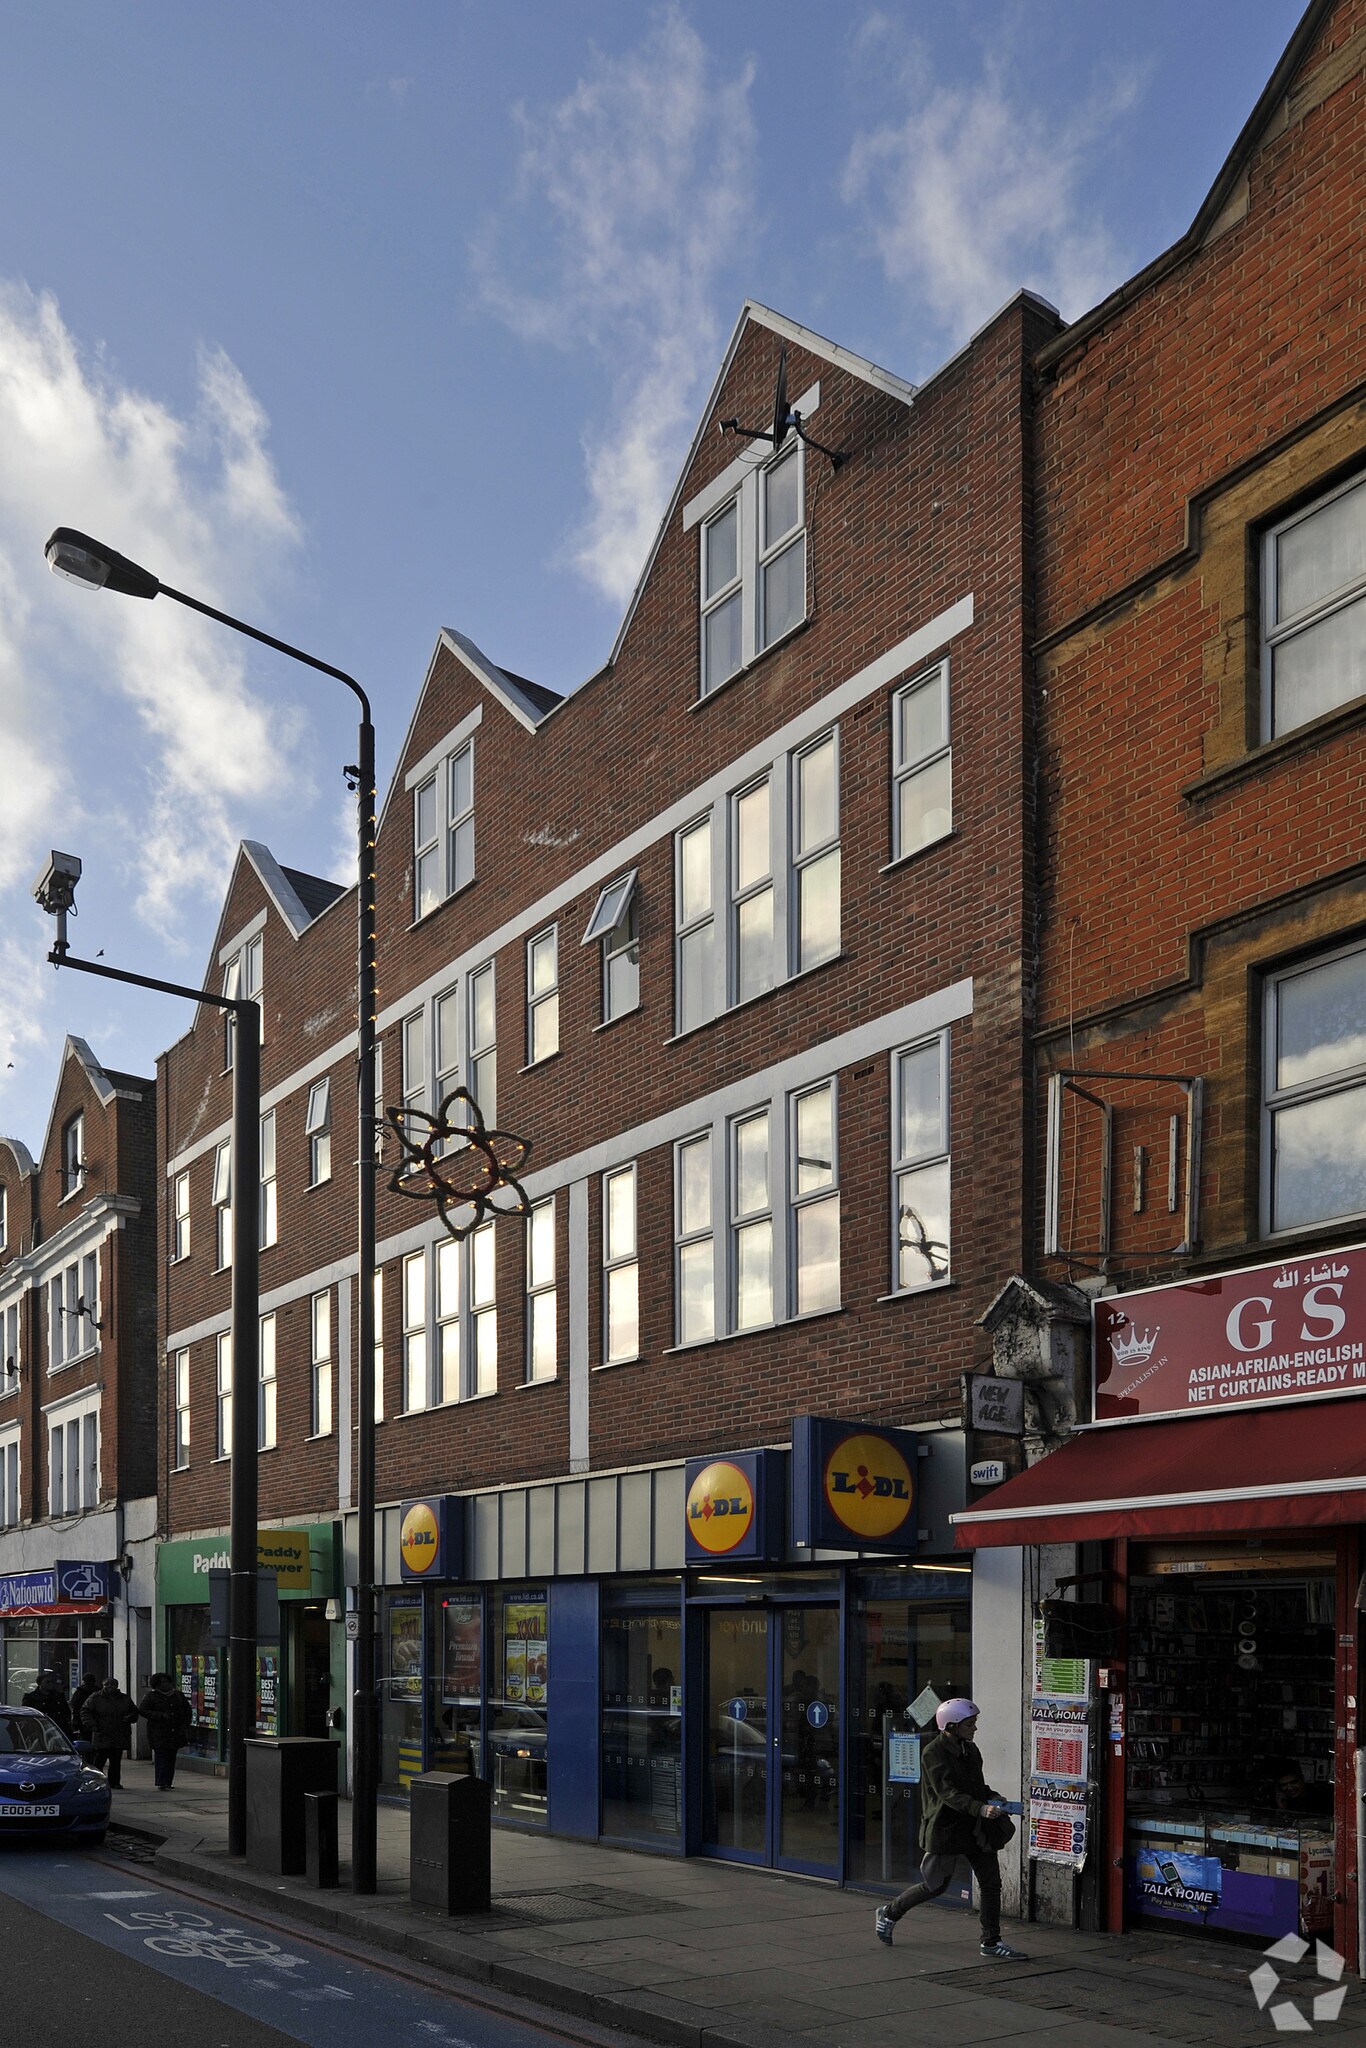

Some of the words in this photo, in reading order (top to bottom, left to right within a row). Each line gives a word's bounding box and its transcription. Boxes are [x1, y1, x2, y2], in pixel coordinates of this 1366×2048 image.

[1107, 1311, 1126, 1326] 12
[1225, 1296, 1277, 1353] G
[1300, 1282, 1346, 1342] S
[1137, 1345, 1152, 1354] KING
[1116, 1364, 1159, 1402] SPECIALISTS
[1158, 1355, 1169, 1368] IN
[1188, 1384, 1216, 1402] NET
[1219, 1364, 1349, 1398] CURTAINS-READY
[978, 1385, 1010, 1404] NEW
[973, 1464, 999, 1480] swift
[448, 1640, 478, 1651] Premium
[455, 1651, 476, 1661] Brand
[181, 1674, 192, 1684] BEST
[204, 1676, 216, 1686] BEST
[261, 1679, 274, 1690] BEST
[204, 1686, 216, 1697] ODDS
[261, 1689, 275, 1700] ODDS
[1032, 1708, 1055, 1719] TALK
[1056, 1710, 1087, 1721] HOME
[1031, 1787, 1053, 1798] TALK
[1055, 1789, 1086, 1801] HOME
[34, 1805, 56, 1815] PYS
[1032, 1800, 1042, 1808] Pay
[1071, 1804, 1085, 1812] SIM
[1142, 1882, 1174, 1897] TALK
[1175, 1888, 1214, 1904] HOME
[1151, 1896, 1162, 1905] Pay
[1172, 1901, 1182, 1909] you
[1193, 1904, 1206, 1912] SIM
